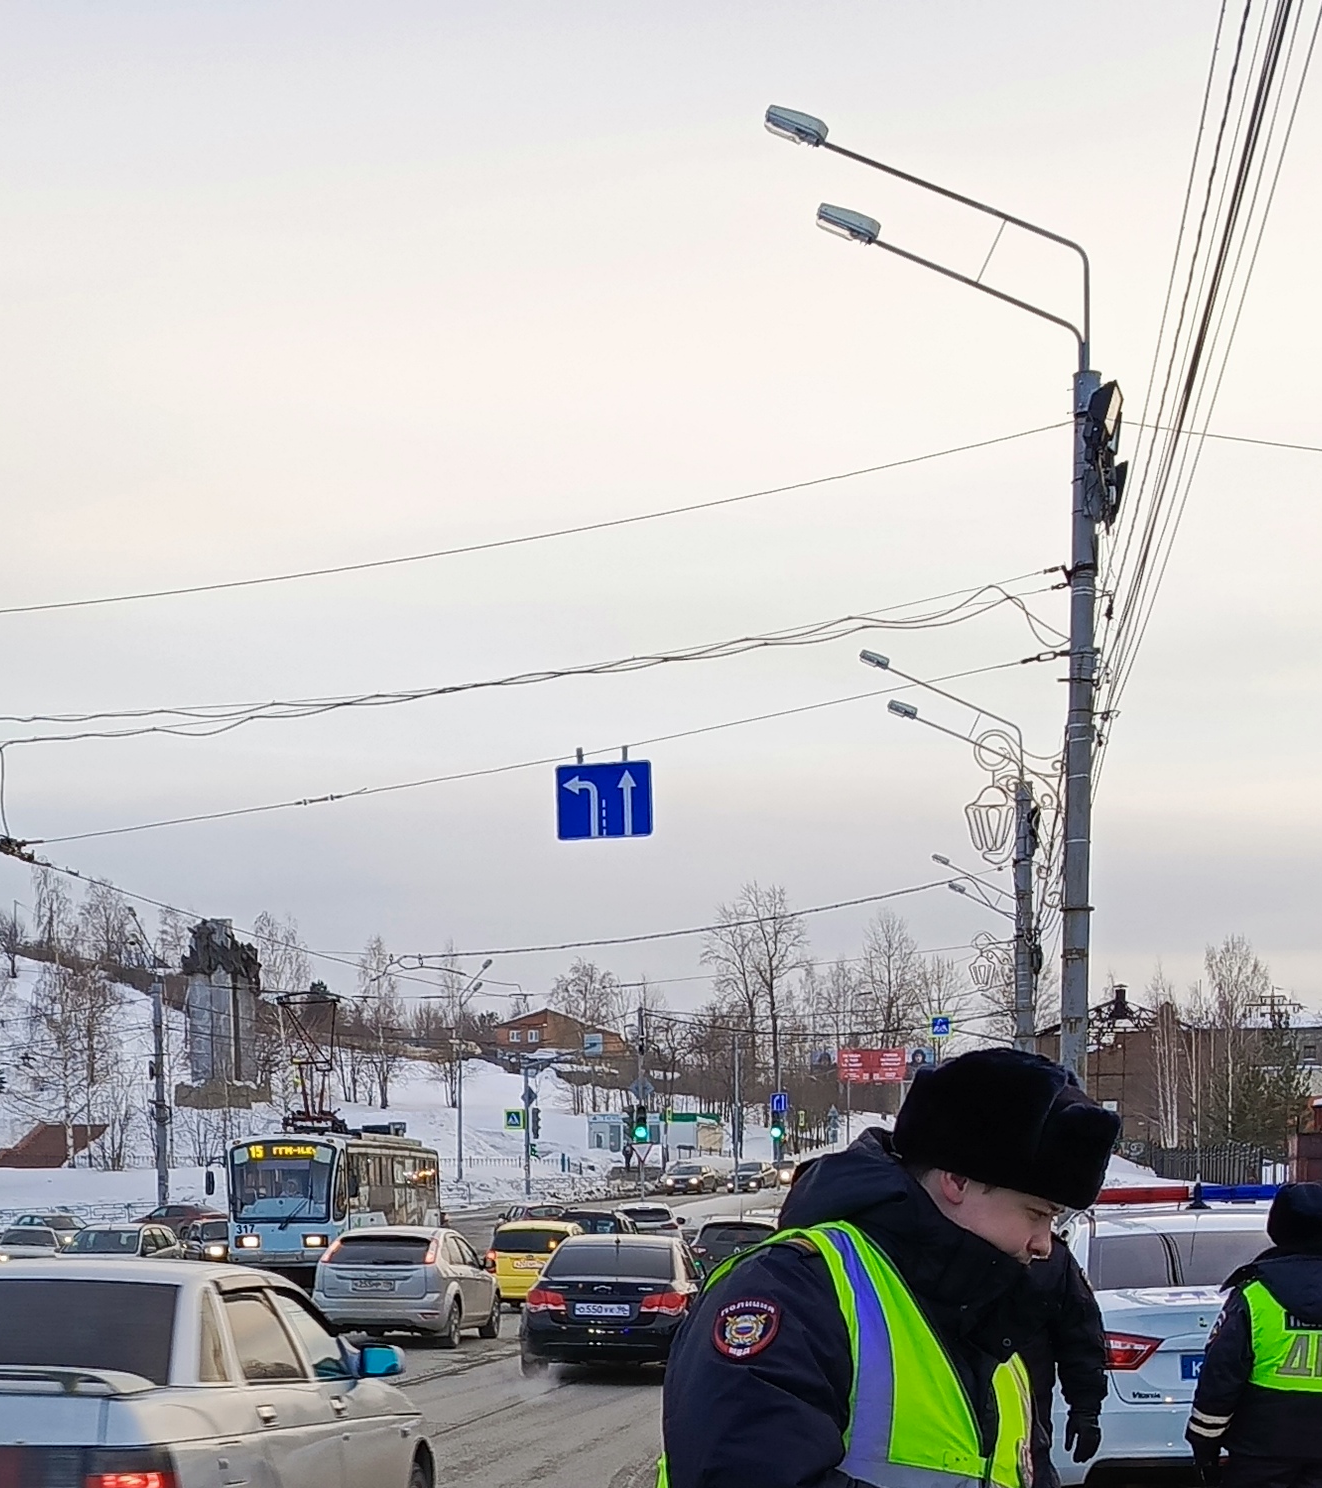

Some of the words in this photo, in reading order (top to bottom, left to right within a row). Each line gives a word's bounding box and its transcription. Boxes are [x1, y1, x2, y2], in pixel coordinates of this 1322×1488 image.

[249, 1145, 264, 1158] 15
[236, 1225, 255, 1234] 317
[720, 1300, 776, 1317] ПОЛИЦИЯ
[728, 1346, 751, 1357] МВД
